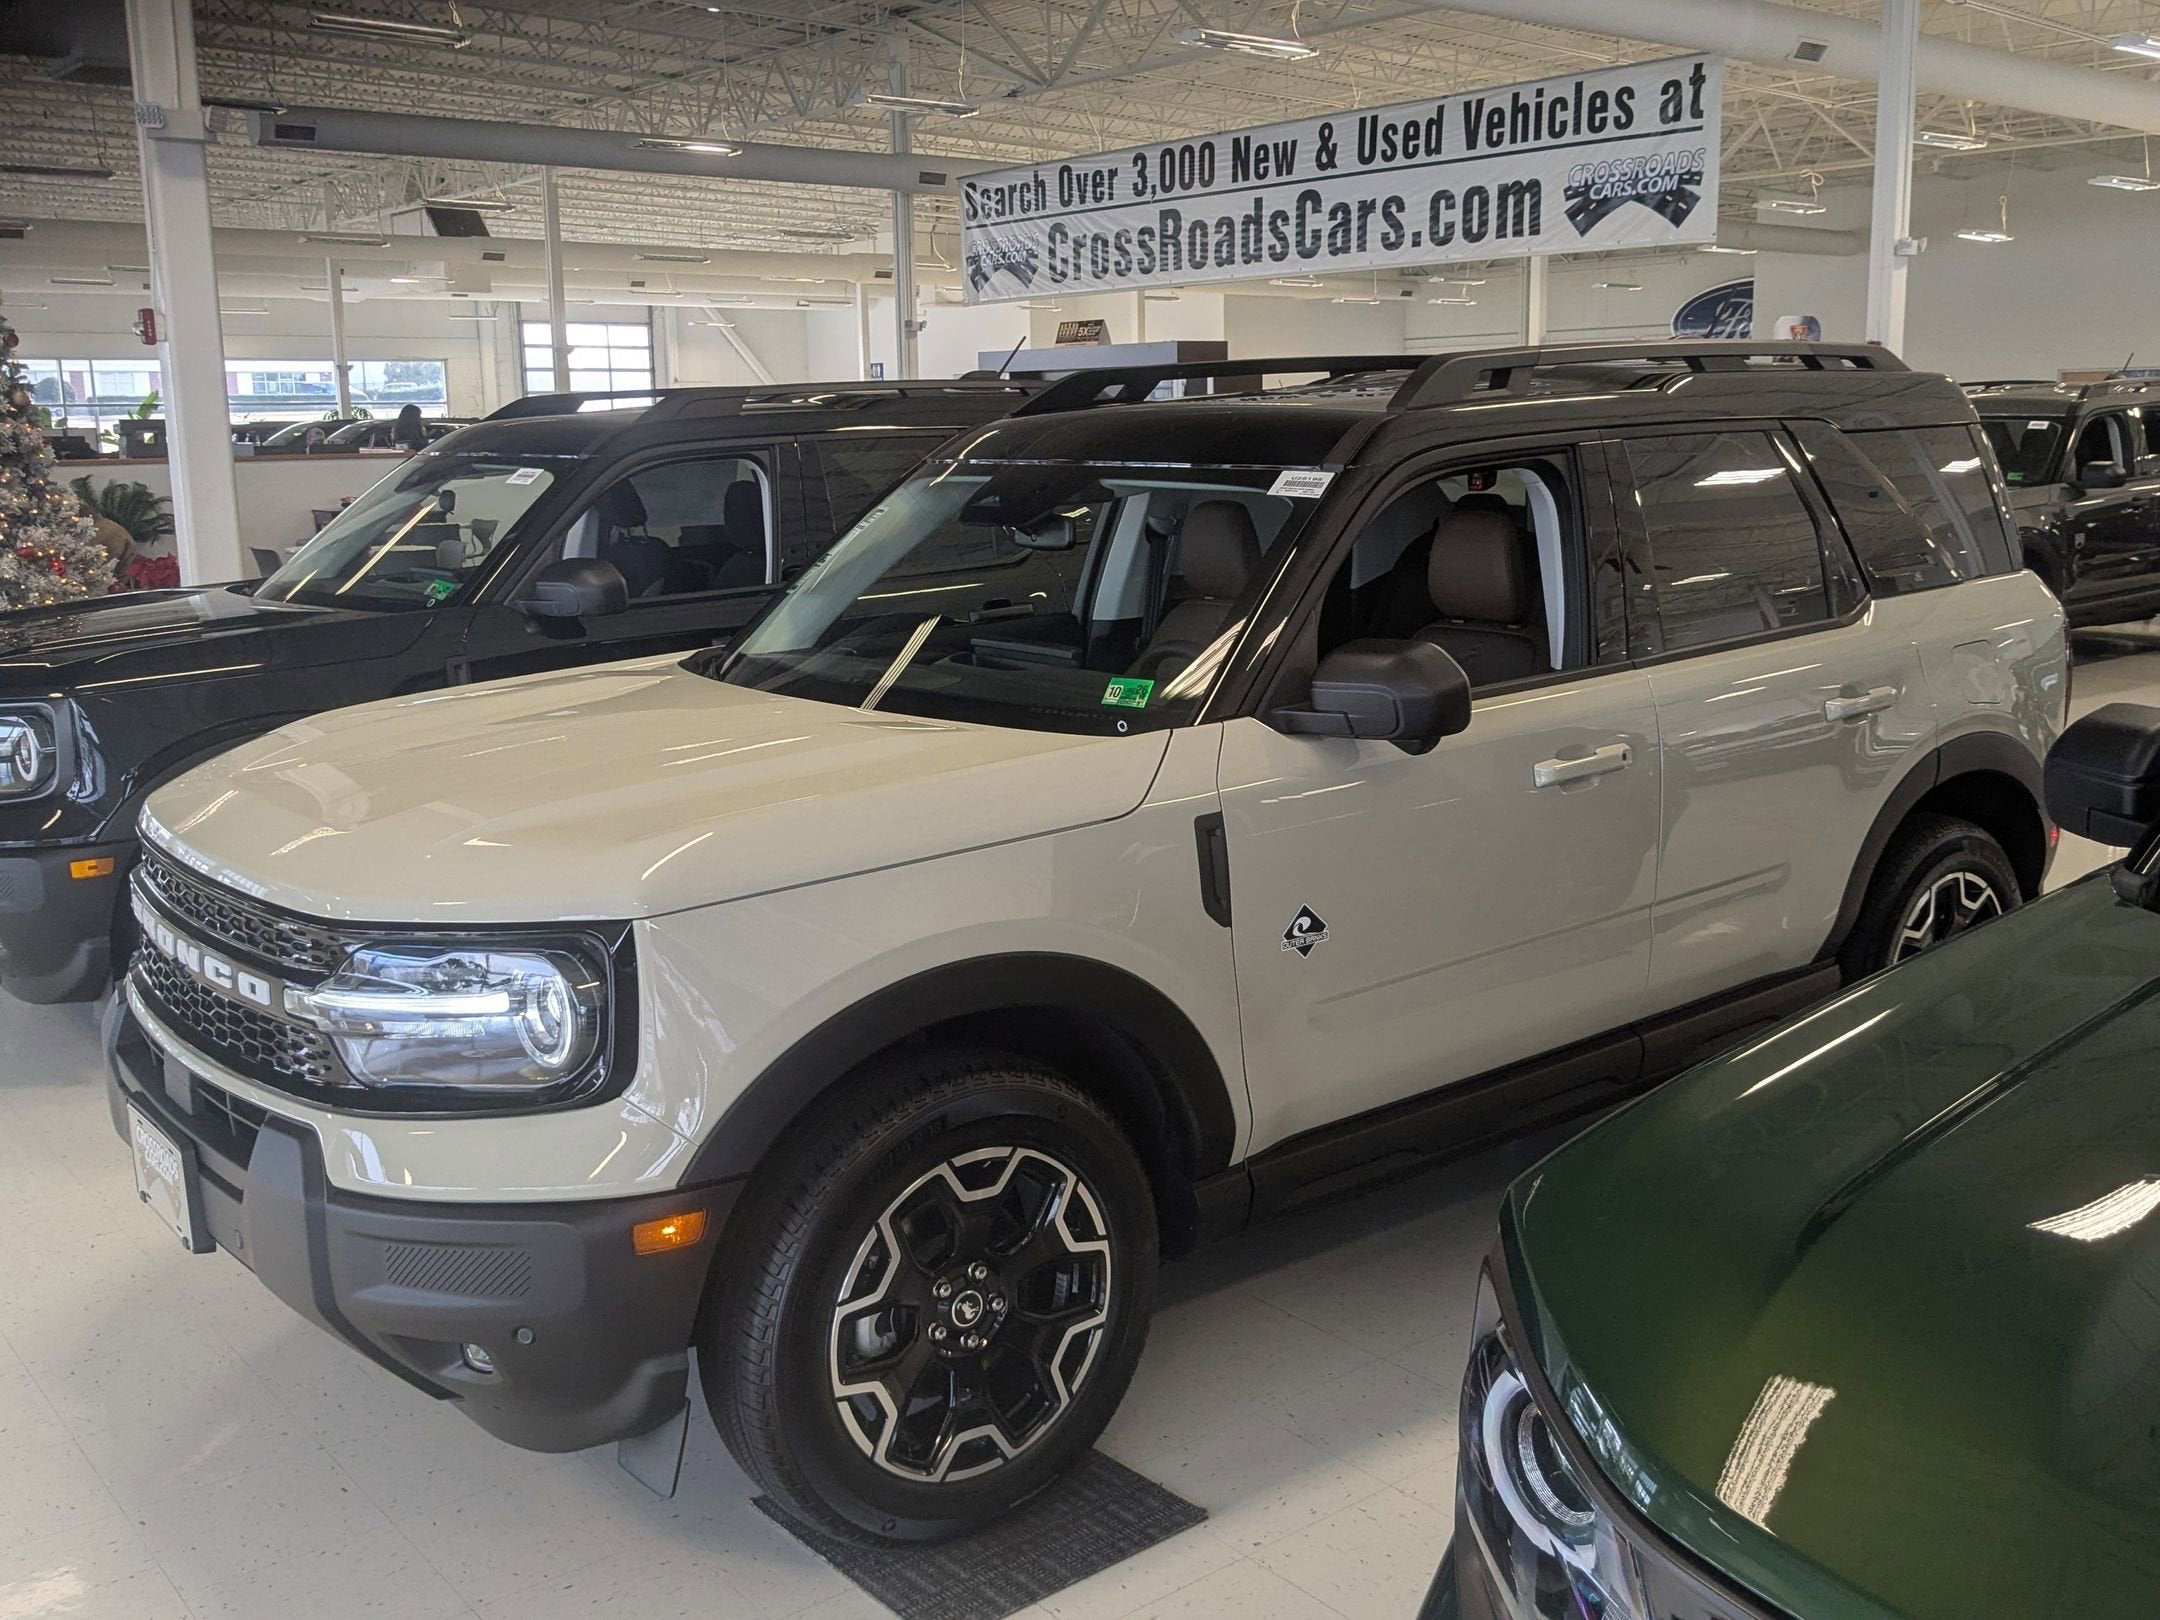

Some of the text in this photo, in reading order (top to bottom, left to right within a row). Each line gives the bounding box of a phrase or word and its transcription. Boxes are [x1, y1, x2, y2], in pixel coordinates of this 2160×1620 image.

[965, 62, 1706, 221] Search Over 3,000 New & Used Vehicles at
[1567, 148, 1706, 188] CROSSROADS
[1589, 174, 1680, 200] CARS.COM
[1048, 178, 1542, 283] CrossRoadsCars.com
[1108, 686, 1122, 698] 10
